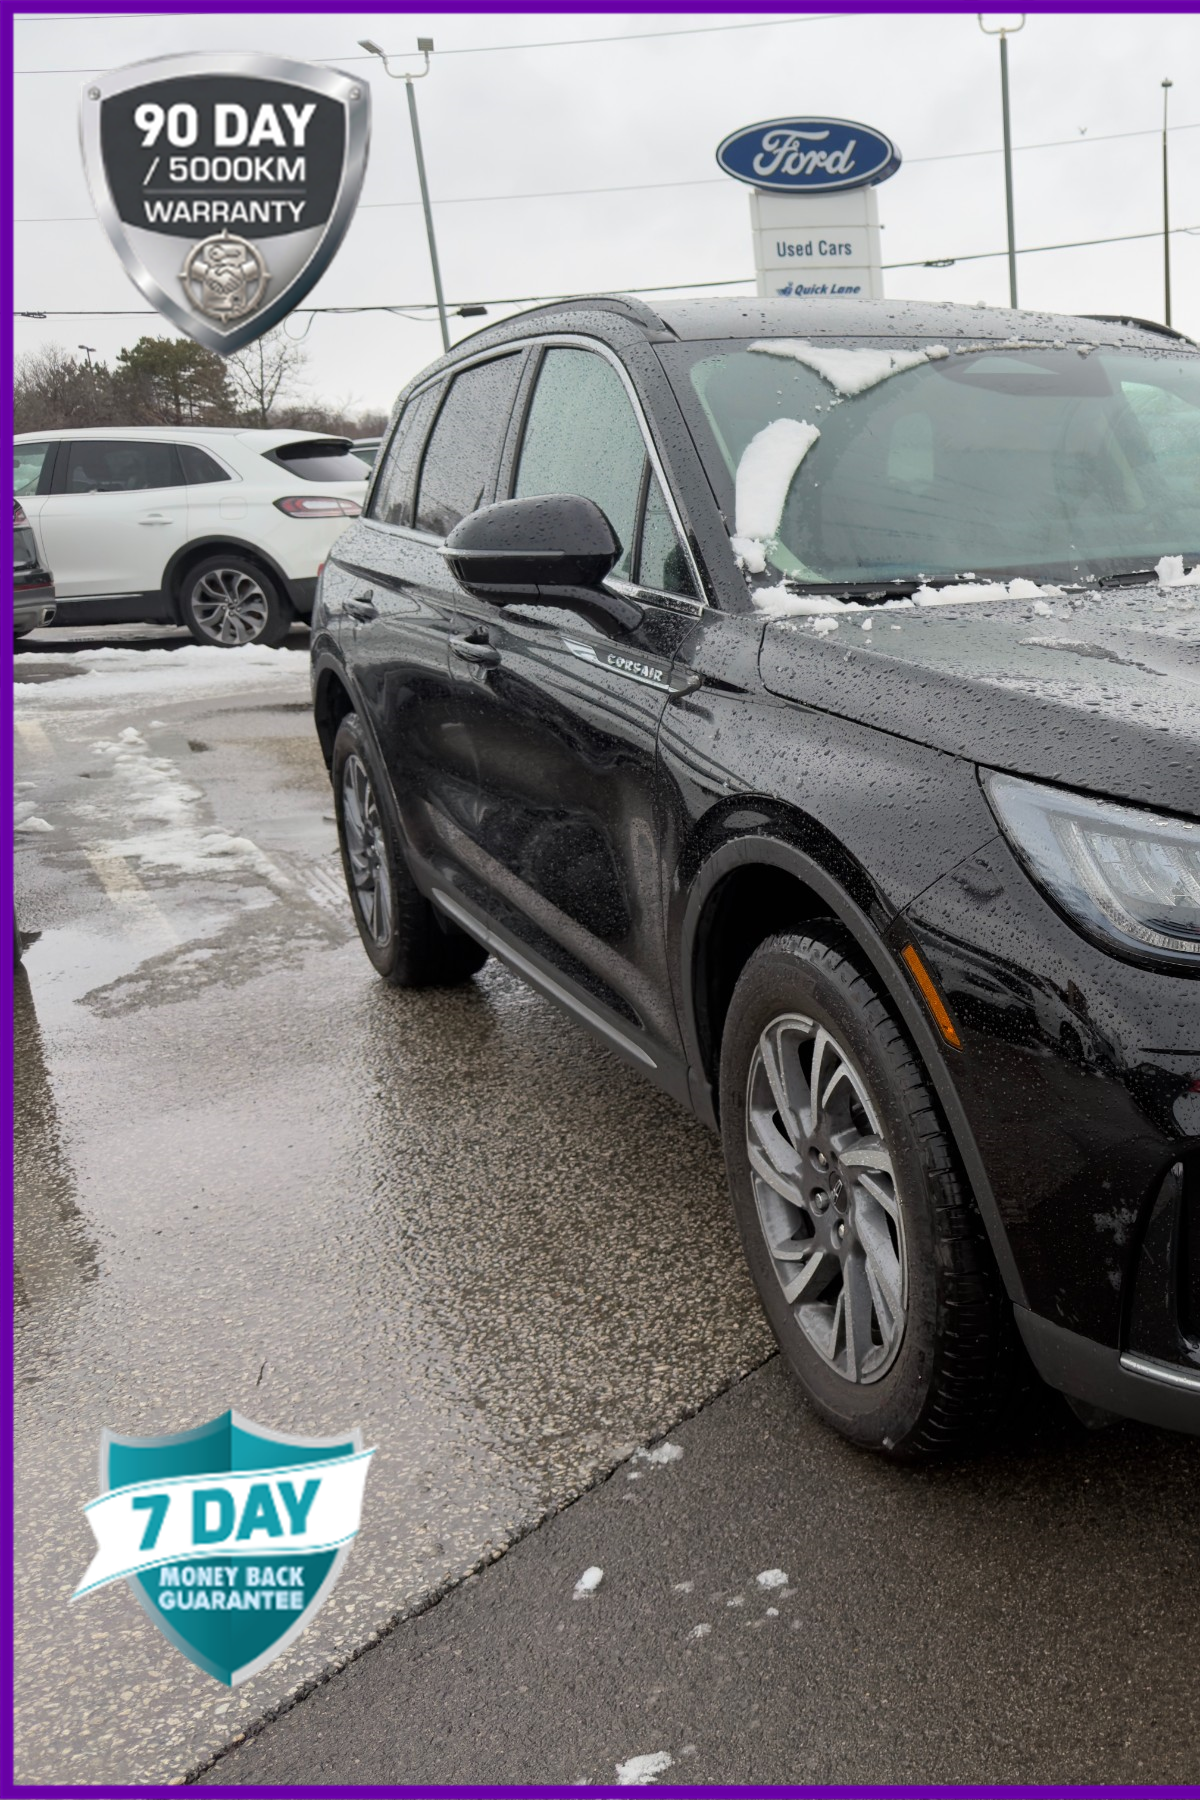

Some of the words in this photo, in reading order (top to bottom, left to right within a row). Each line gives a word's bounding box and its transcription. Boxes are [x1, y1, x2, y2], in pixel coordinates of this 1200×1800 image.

[753, 129, 857, 176] Ford
[776, 241, 813, 258] Used
[818, 240, 852, 256] Cars
[794, 284, 827, 296] Quick
[830, 283, 861, 295] Lane
[607, 653, 663, 682] CORSAIR
